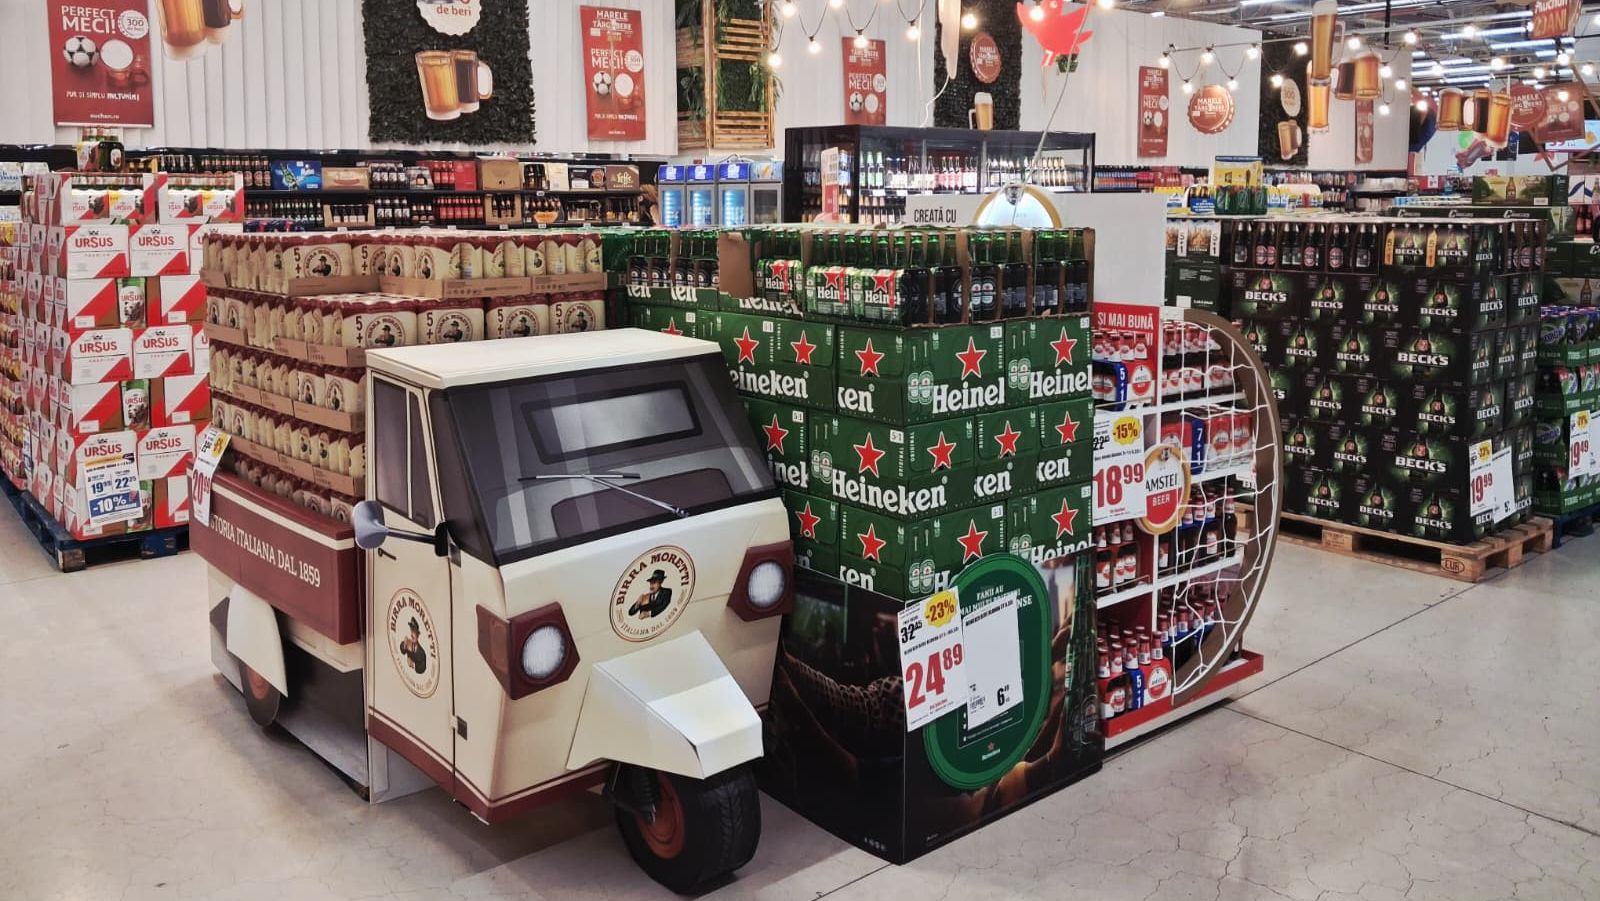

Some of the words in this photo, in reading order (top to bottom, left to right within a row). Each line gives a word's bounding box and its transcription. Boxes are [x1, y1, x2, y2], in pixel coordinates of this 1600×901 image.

[61, 5, 116, 19] PERFECT
[436, 5, 450, 16] de
[452, 4, 471, 17] beri
[597, 10, 628, 20] MARELE
[62, 17, 116, 34] MECI!
[591, 48, 624, 58] PERFCT
[591, 56, 624, 69] MECI!
[913, 206, 944, 224] CREATĂ
[945, 210, 957, 224] CU
[75, 235, 113, 249] URSUS
[138, 234, 175, 248] URSUS
[1394, 248, 1424, 256] BECK'S
[1245, 291, 1287, 302] BECK'S
[1517, 295, 1538, 307] BECK'S
[1311, 300, 1343, 309] BECK'S
[1364, 303, 1399, 312] BECK'S
[1480, 299, 1503, 312] BECK'S
[1420, 307, 1458, 316] BECK'S
[1108, 314, 1126, 327] MAI
[1128, 313, 1154, 330] BUNĂ
[79, 340, 118, 354] URSUS
[143, 336, 179, 350] URSUS
[1286, 347, 1318, 357] BECK'S
[1336, 352, 1370, 362] BECK'S
[1397, 352, 1449, 366] BECK'S
[1472, 359, 1490, 370] BECK'S
[730, 365, 809, 399] eineken
[1310, 399, 1342, 410] BECK'S
[1514, 396, 1534, 410] BECK'S
[1361, 405, 1397, 416] BECK'S
[1476, 406, 1500, 420] BECK'S
[1418, 412, 1456, 424] BECK'S
[1112, 422, 1138, 440] -15%
[84, 443, 123, 458] URSUS
[146, 437, 182, 451] URSUS
[1284, 444, 1316, 456] BECK'S
[1334, 451, 1367, 463] BECK'S
[1395, 456, 1447, 473] BECK'S
[832, 468, 947, 516] Heineken
[92, 495, 127, 513] -10%
[1152, 494, 1170, 506] BEER
[1307, 496, 1340, 508] BECK'S
[1359, 505, 1394, 518] BECK'S
[1415, 516, 1452, 530] BECK'S
[235, 527, 276, 567] ITALIANA
[277, 549, 298, 578] DAL
[299, 560, 321, 588] 1859
[615, 561, 648, 606] BIRRA
[650, 551, 690, 587] MORETTI
[994, 585, 1004, 595] AU
[925, 597, 955, 622] -23%
[390, 596, 408, 633] BIRRA
[408, 596, 437, 659] MORETTI
